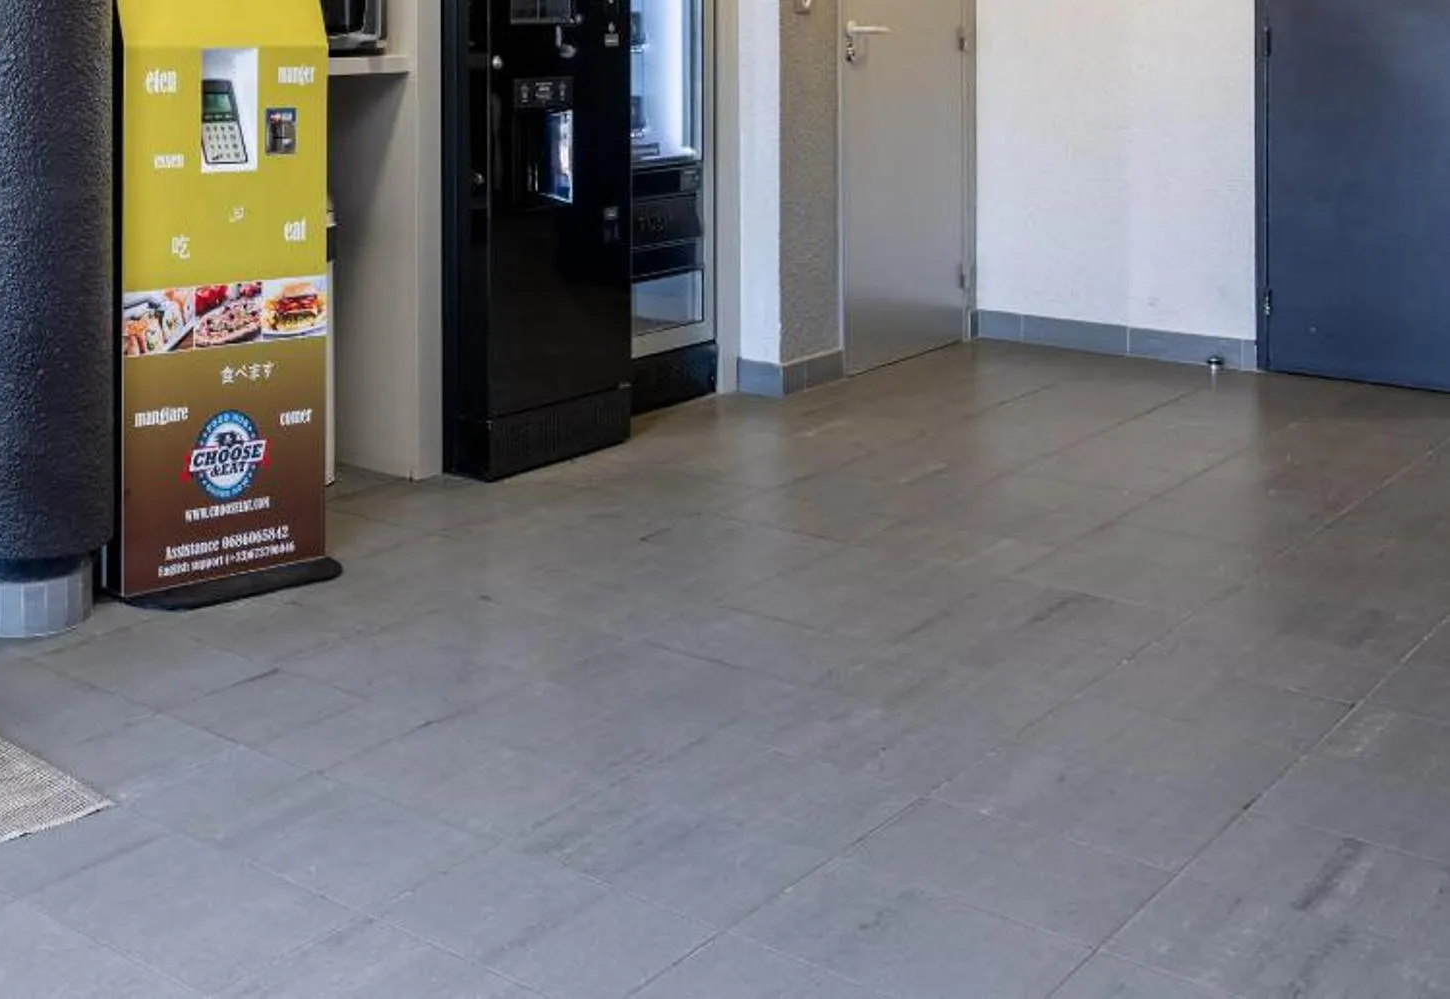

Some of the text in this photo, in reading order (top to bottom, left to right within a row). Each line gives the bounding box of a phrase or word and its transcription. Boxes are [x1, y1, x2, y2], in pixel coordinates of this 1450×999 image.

[284, 216, 307, 242] eat
[219, 361, 276, 385] 食べます
[134, 406, 189, 428] mangiare
[193, 443, 263, 468] CHOOSE
[210, 461, 246, 478] &EAT
[164, 540, 220, 561] Assistance
[191, 555, 224, 573] support
